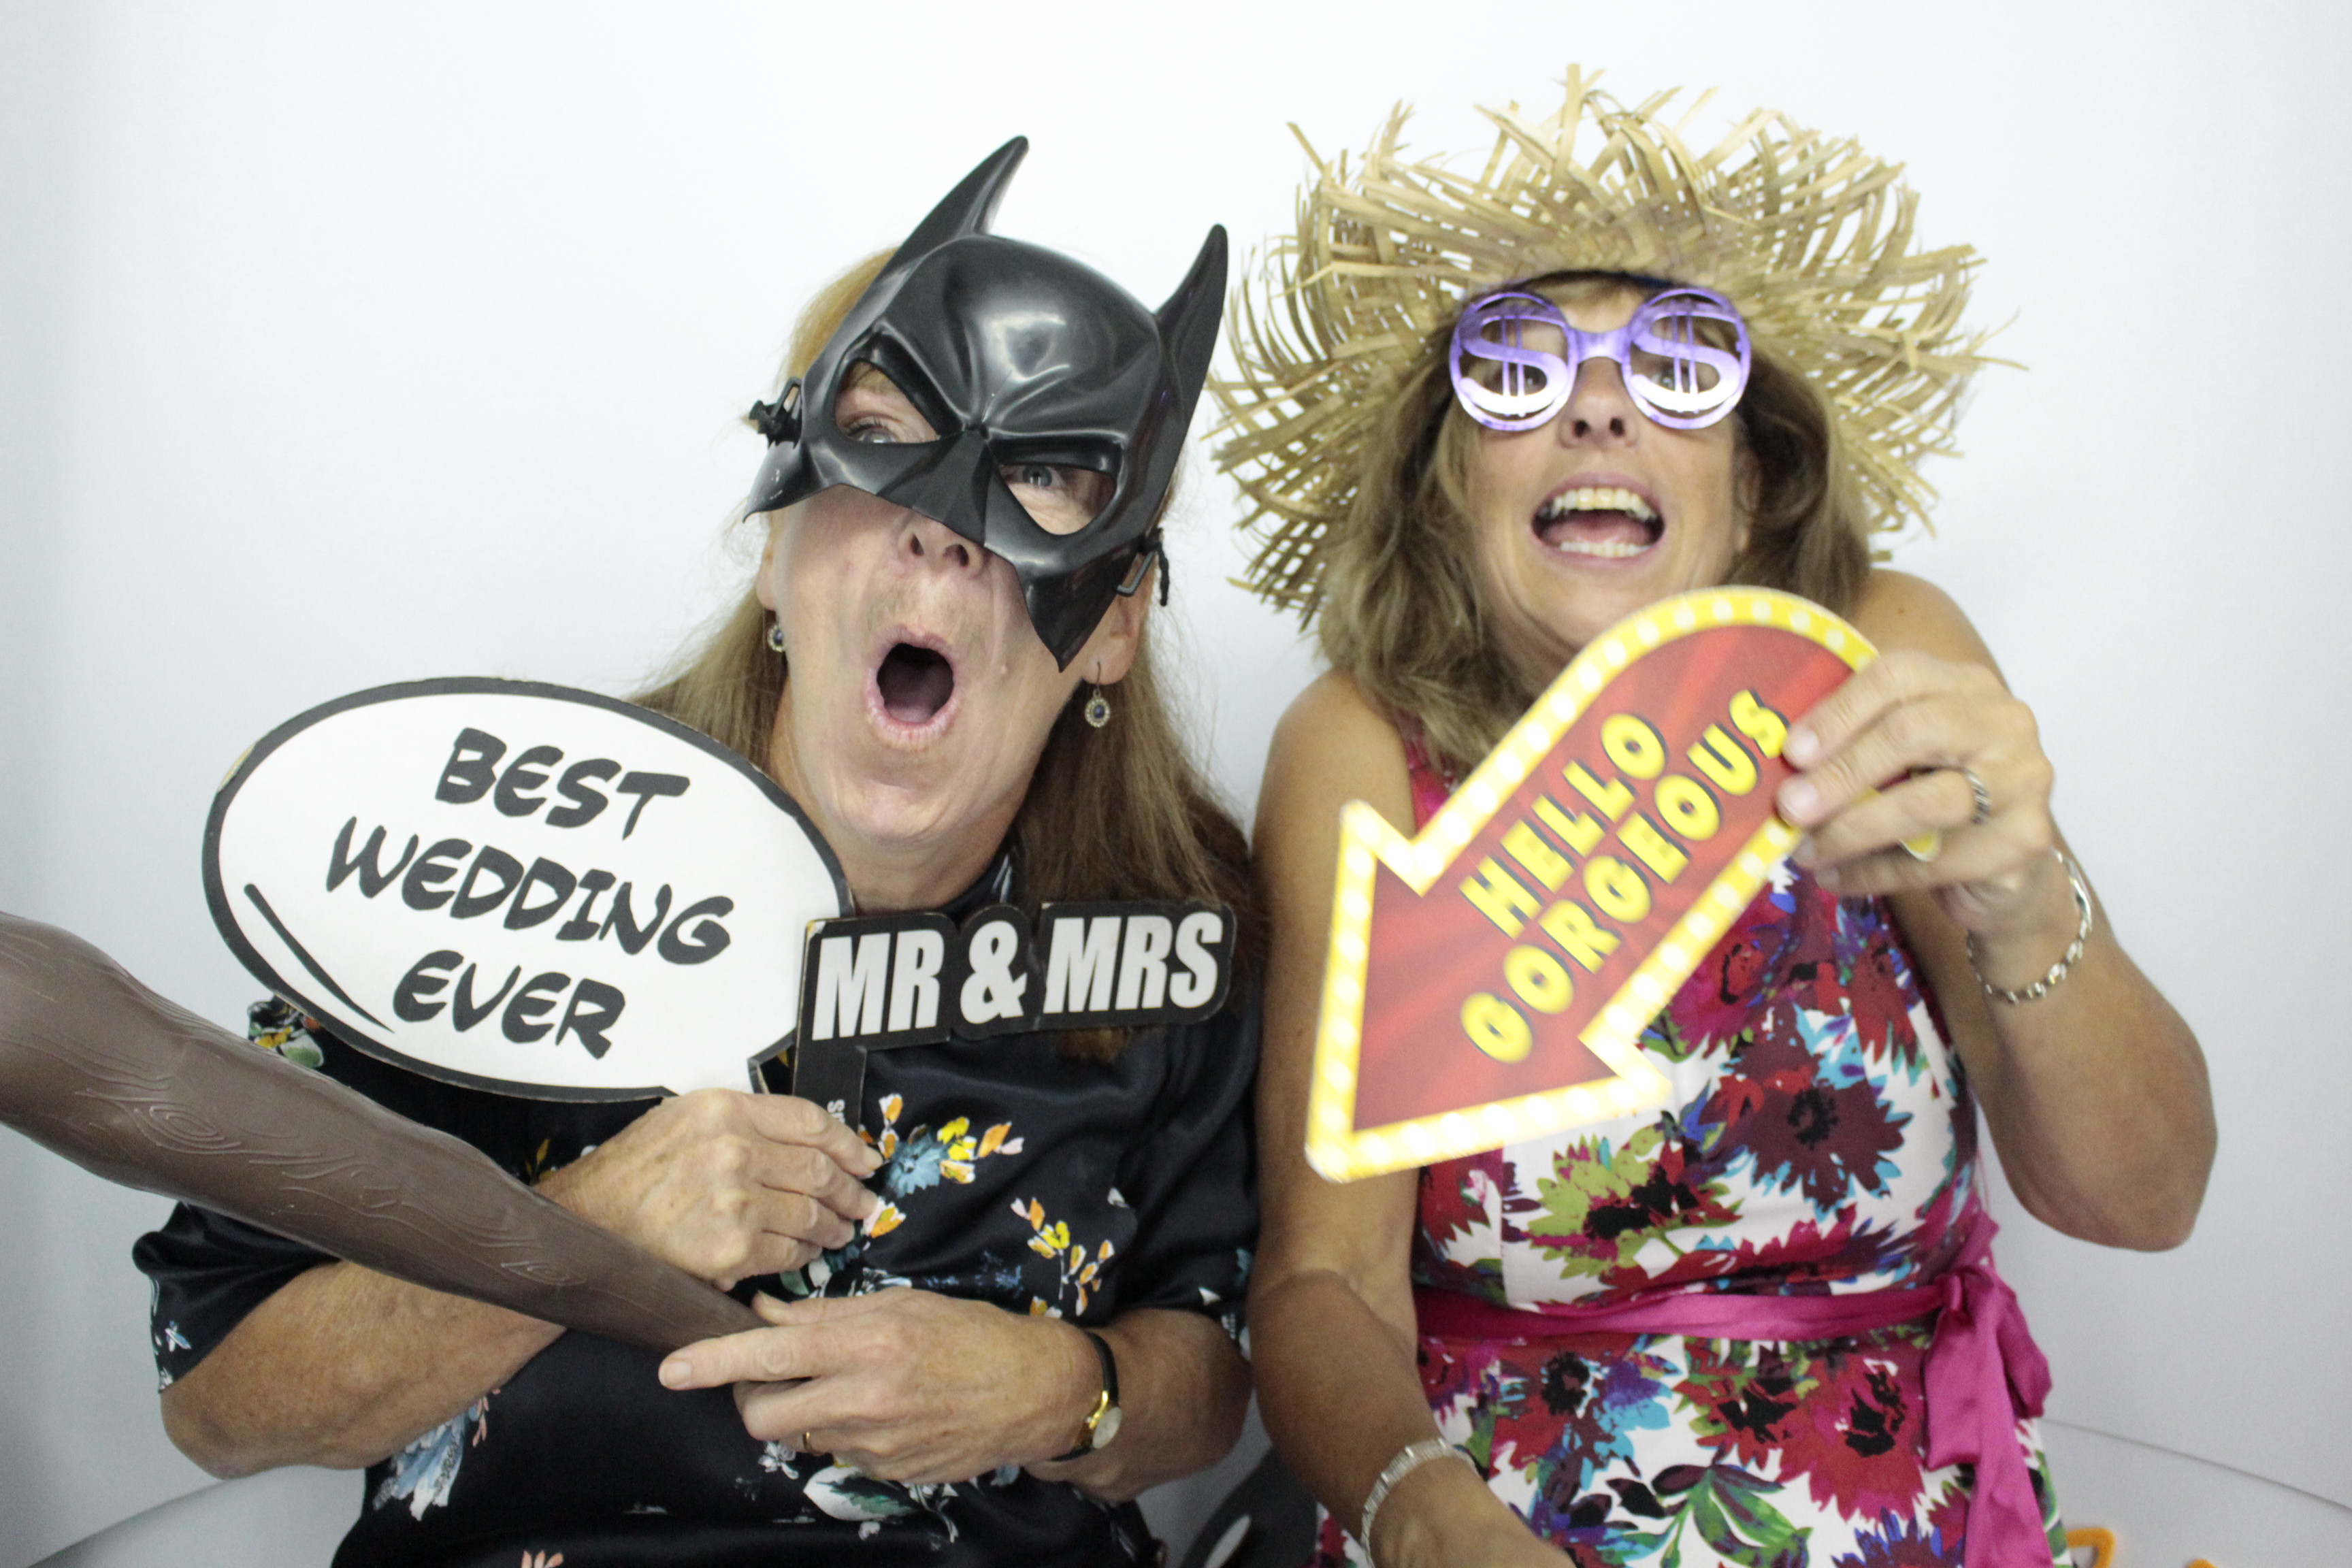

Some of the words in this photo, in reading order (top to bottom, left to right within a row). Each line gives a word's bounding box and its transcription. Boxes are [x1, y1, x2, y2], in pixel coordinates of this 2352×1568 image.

[435, 726, 691, 841] BEST
[1458, 713, 1667, 941] HELLO
[325, 816, 734, 965] WEDDING
[1460, 689, 1791, 1064] GORGEOUS
[392, 949, 626, 1060] EVER
[811, 929, 945, 1041] MR
[960, 919, 1028, 1024] &
[1043, 911, 1224, 1014] MRS
